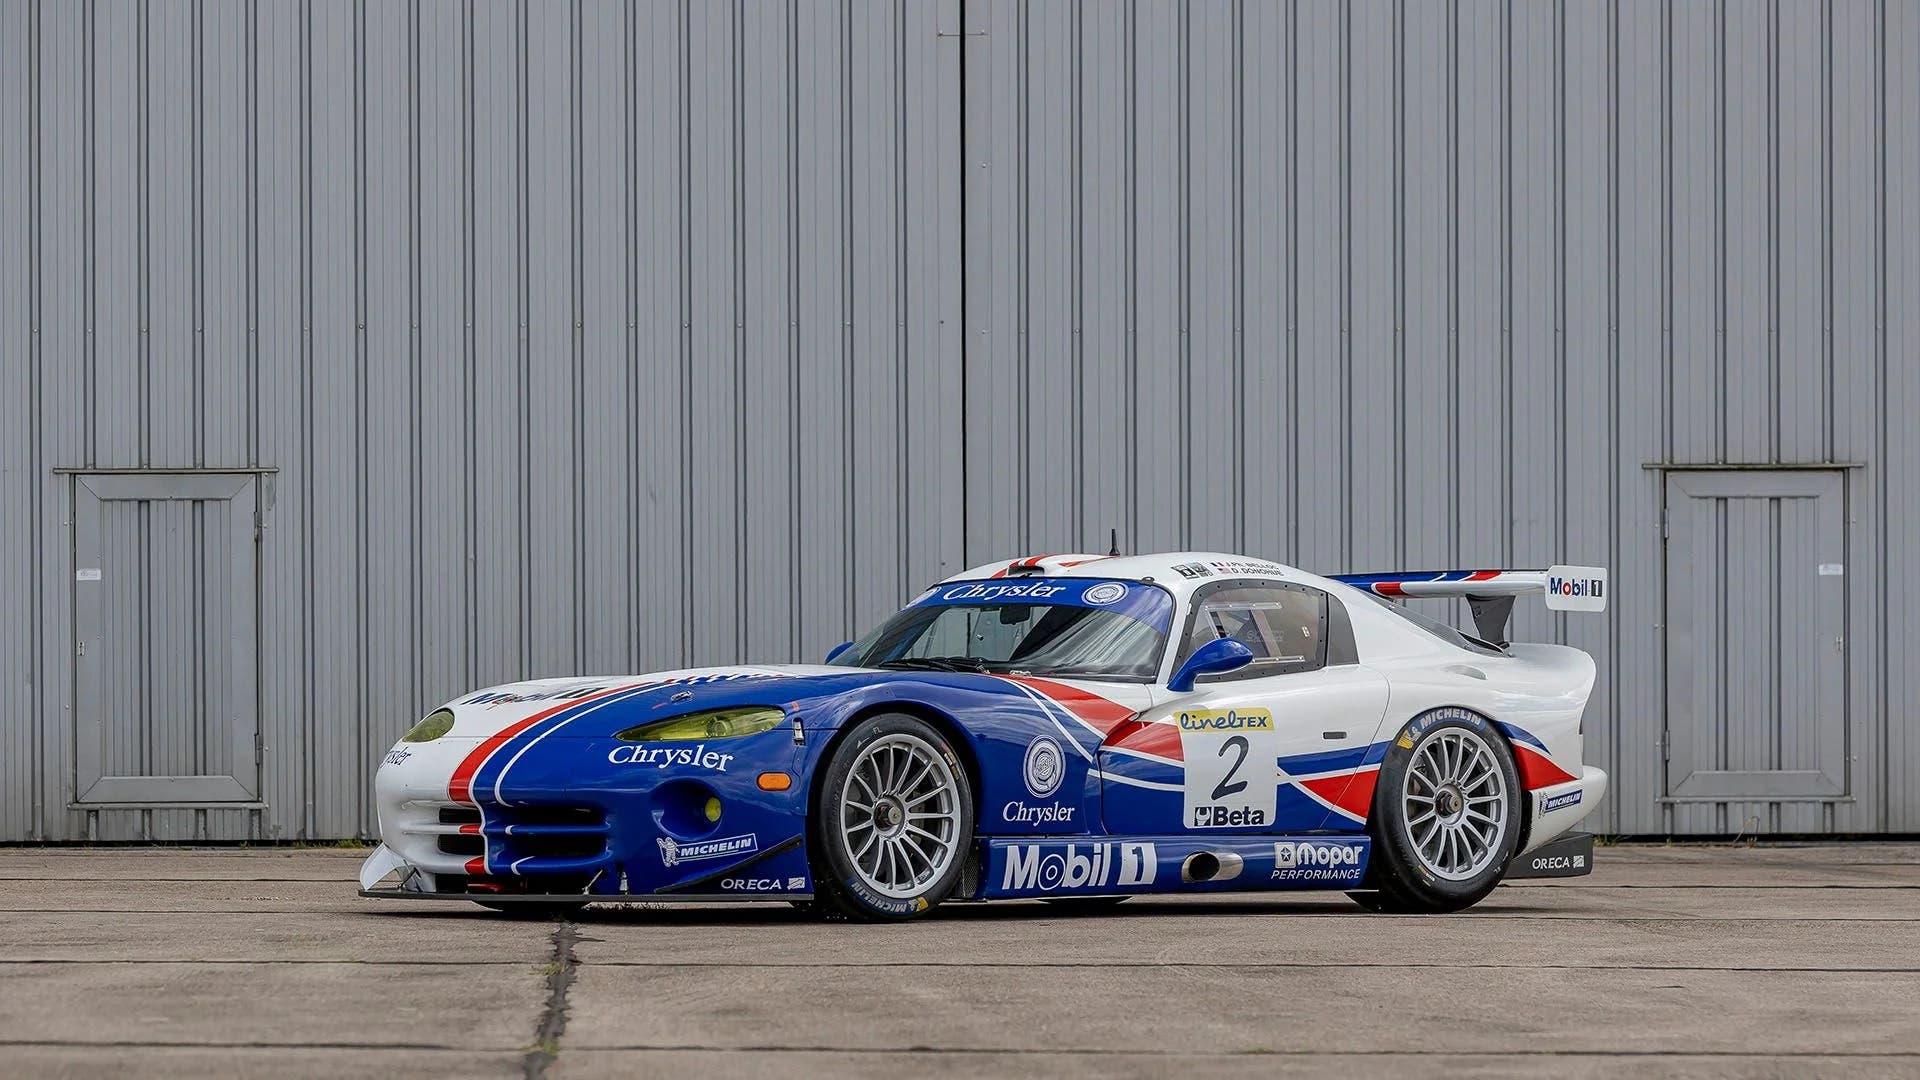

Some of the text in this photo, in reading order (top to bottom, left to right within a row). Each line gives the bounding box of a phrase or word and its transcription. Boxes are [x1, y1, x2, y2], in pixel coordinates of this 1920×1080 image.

[943, 581, 1066, 600] Chrysler
[1550, 577, 1601, 597] Mobil 1
[1420, 708, 1481, 729] MICHELIN
[608, 744, 734, 772] Chrysler
[1211, 735, 1250, 801] 2
[1548, 792, 1581, 809] MICHELIN
[1002, 801, 1075, 827] Chrysler
[1212, 806, 1265, 826] Beta
[680, 838, 752, 857] MICHELIN
[1297, 842, 1364, 868] Mopar
[1002, 843, 1111, 891] Mobil
[1532, 856, 1570, 870] ORECA
[720, 878, 782, 890] ORECA
[1271, 868, 1361, 880] PERFORMANCE
[851, 882, 907, 912] MICHELIN
